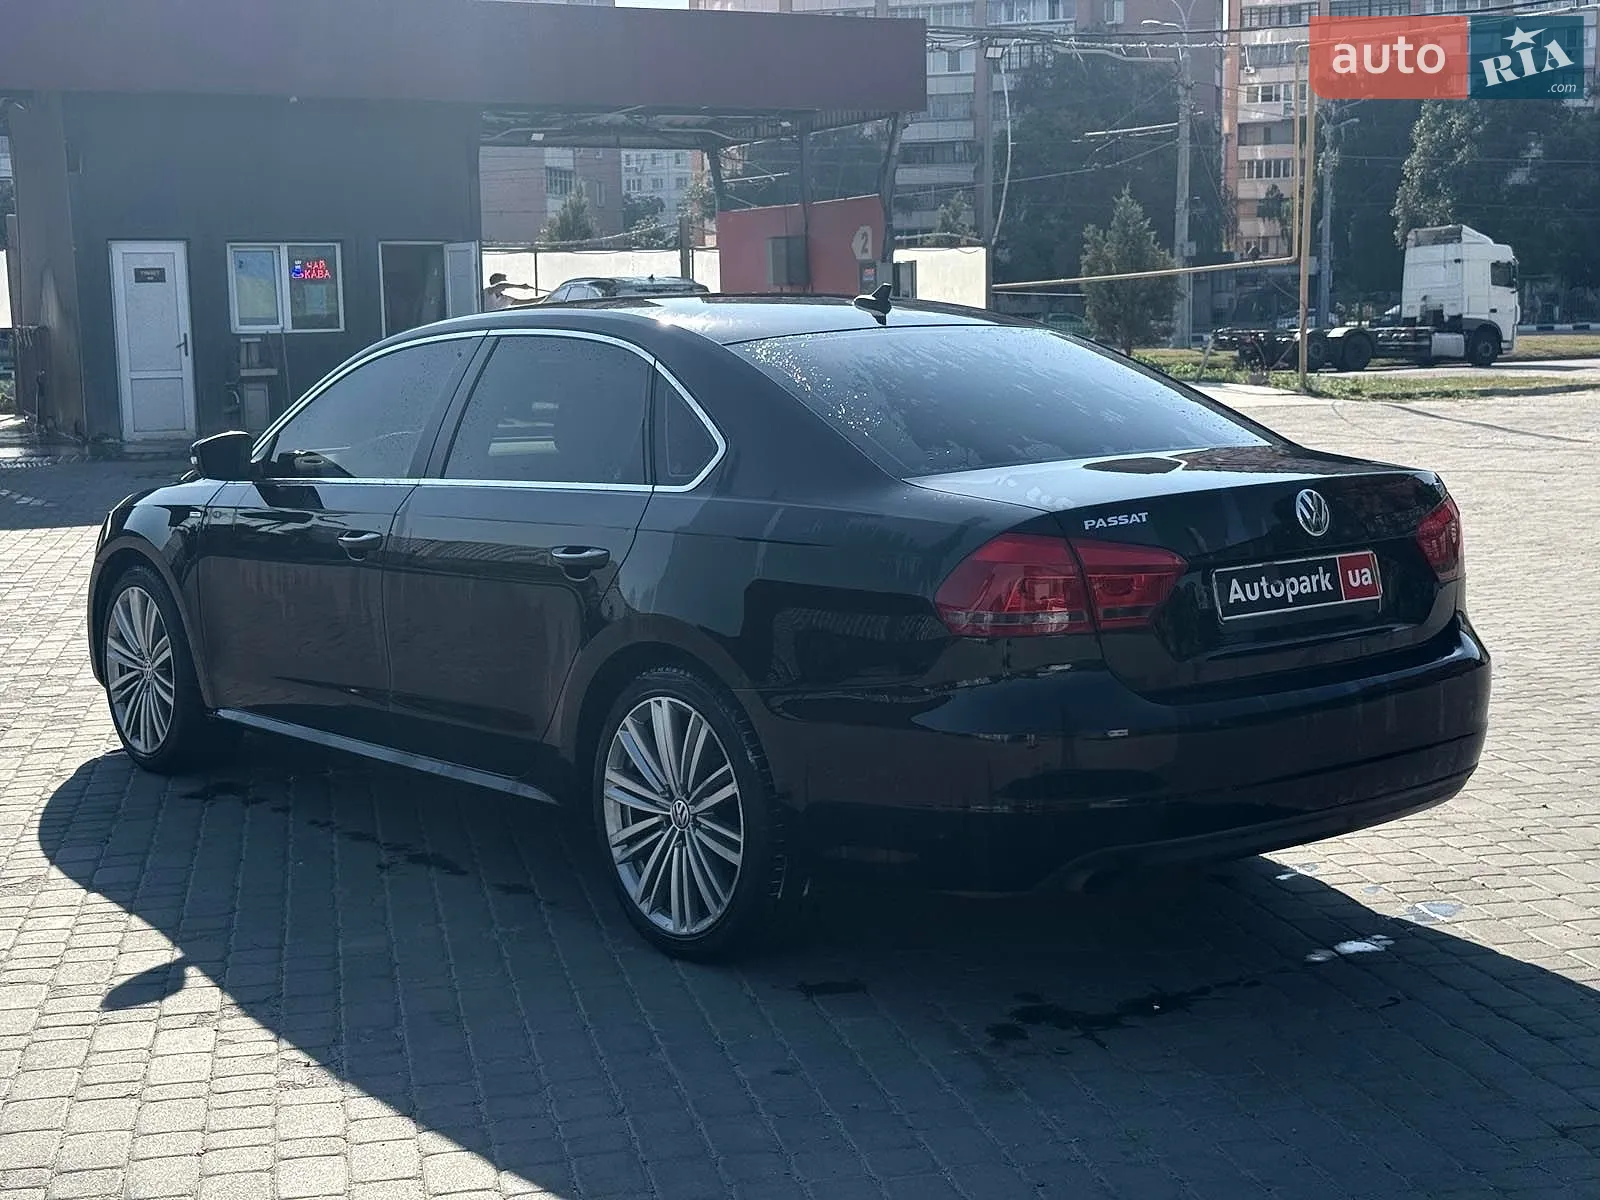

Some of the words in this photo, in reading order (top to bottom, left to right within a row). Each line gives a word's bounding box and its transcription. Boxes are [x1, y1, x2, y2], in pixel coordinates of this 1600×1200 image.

[860, 231, 869, 255] 2
[304, 269, 331, 279] КАВА
[306, 260, 326, 270] ЧАЙ
[1083, 511, 1149, 530] PASSAT
[1228, 566, 1333, 602] Autopark
[1349, 565, 1373, 588] ua
